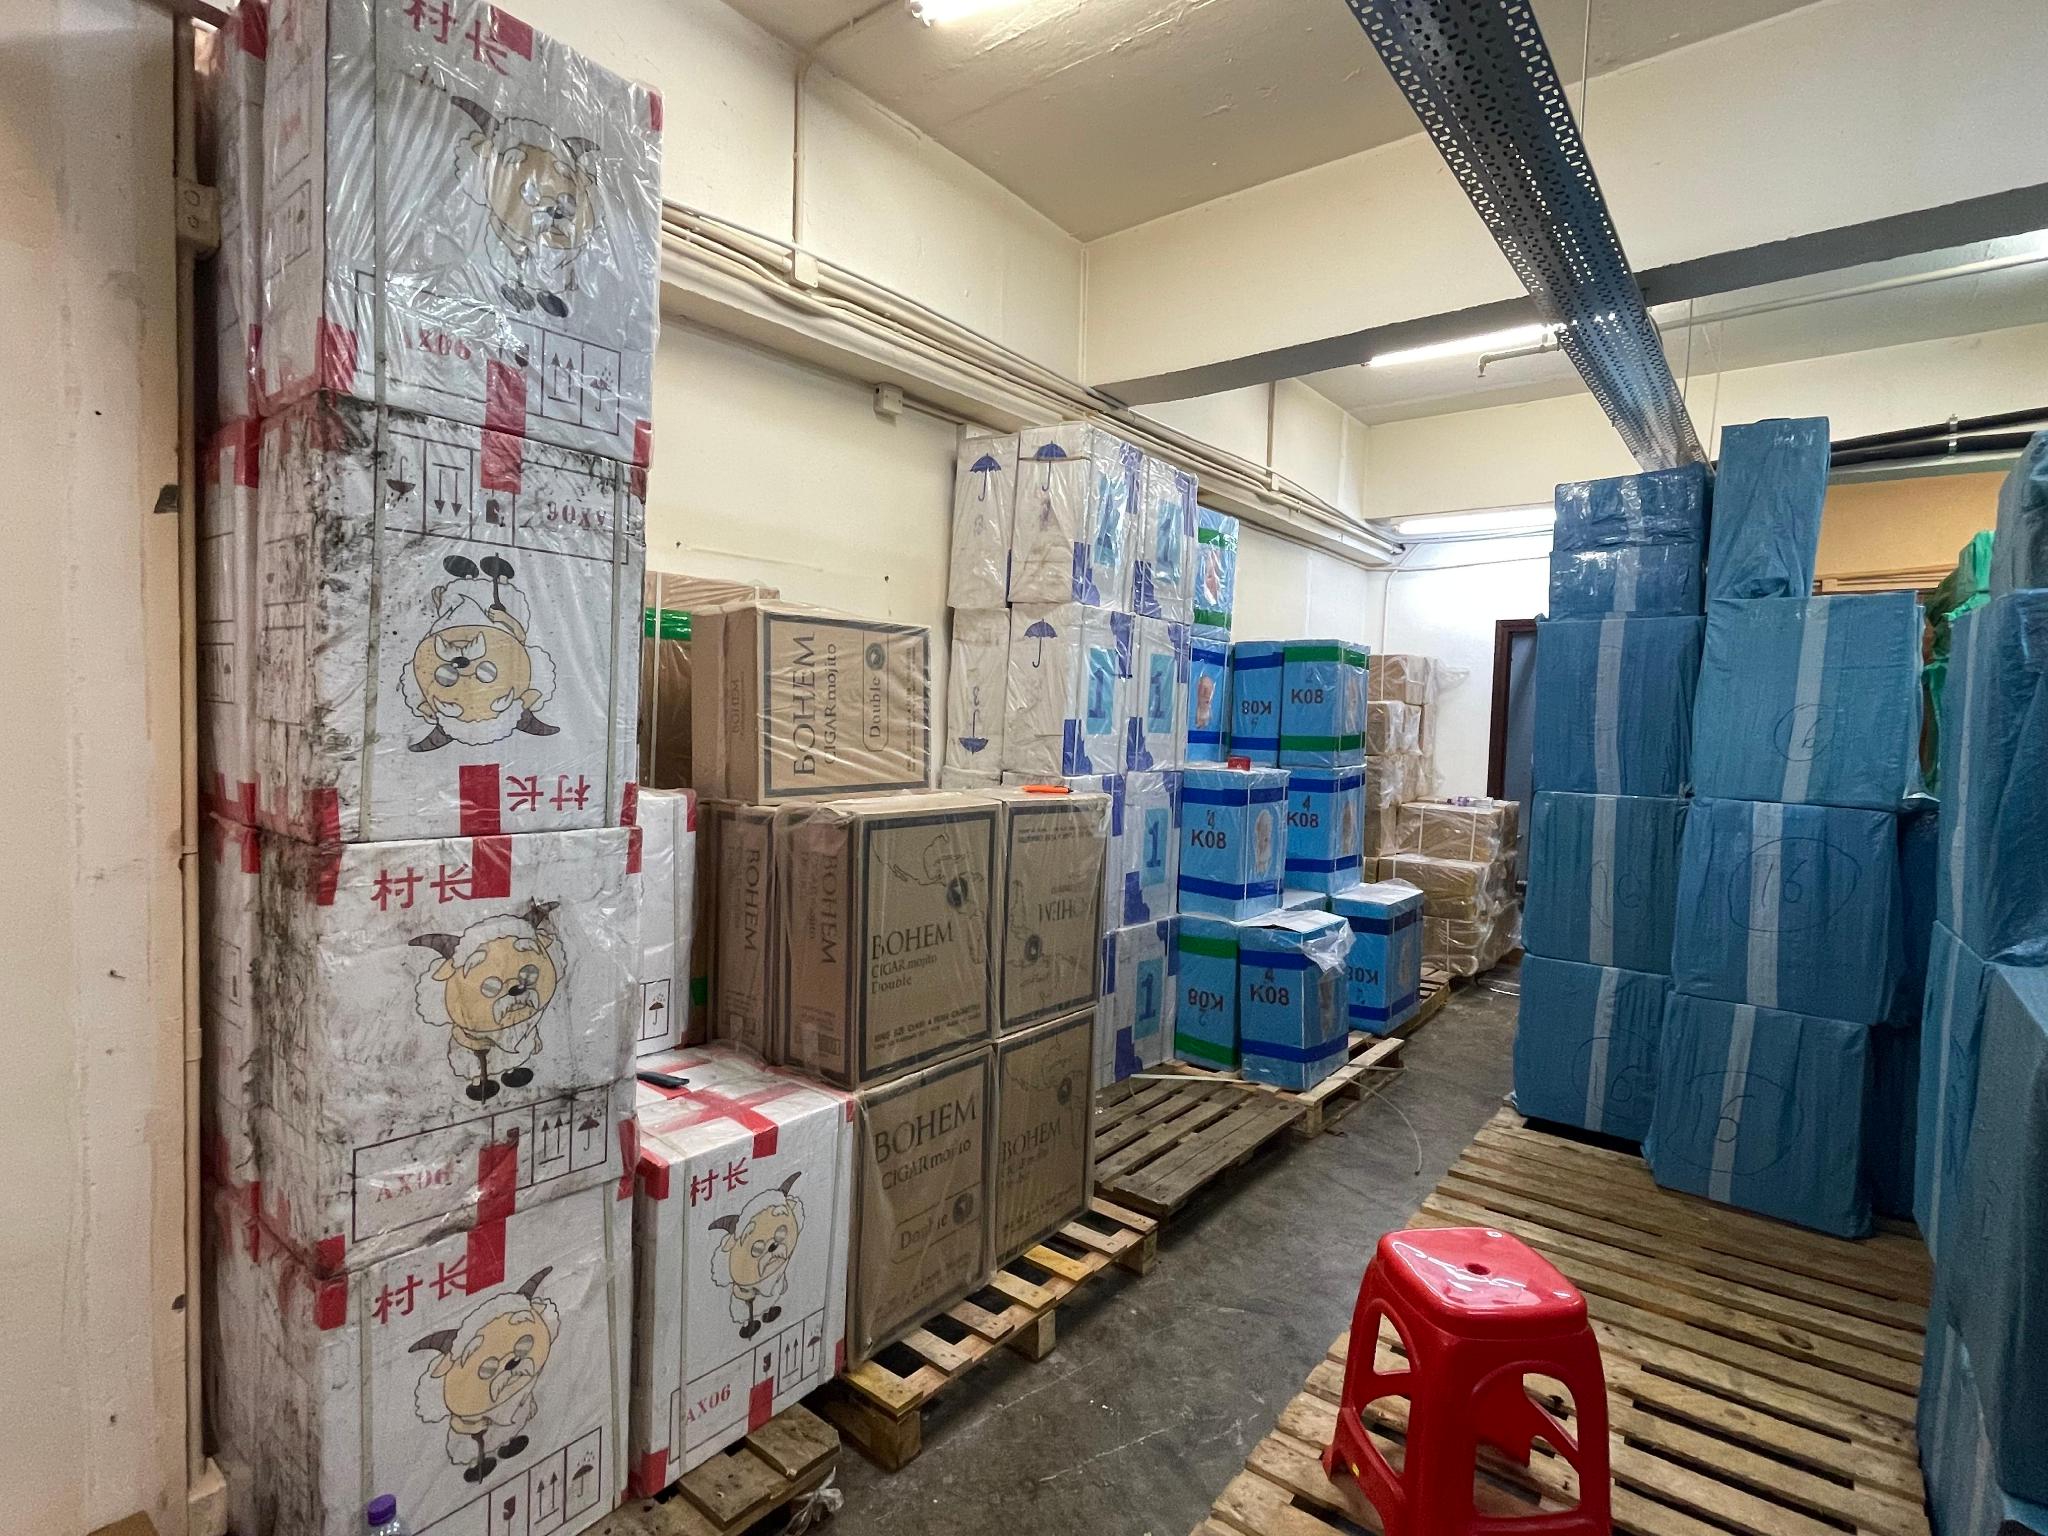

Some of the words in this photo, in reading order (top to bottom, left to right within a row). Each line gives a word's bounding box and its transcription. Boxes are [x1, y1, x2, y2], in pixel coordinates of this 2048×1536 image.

[402, 0, 508, 76] 村长
[793, 632, 815, 776] BOHEM
[870, 677, 881, 738] Double
[1242, 701, 1272, 715] K08
[1291, 689, 1324, 704] K08
[506, 773, 592, 812] 村长
[1303, 795, 1310, 811] 4
[1191, 829, 1227, 849] K08
[1207, 810, 1215, 829] 4
[1287, 811, 1319, 828] K08
[1146, 820, 1161, 868] 1
[371, 863, 474, 911] 村长
[745, 850, 760, 951] BOHEM
[1762, 859, 1808, 907] 16
[820, 855, 838, 964] BOHEM
[872, 921, 954, 960] BOHEM
[872, 975, 912, 994] Double
[1139, 973, 1156, 1021] 1
[1188, 988, 1223, 1012] K08
[1250, 984, 1290, 1006] K08
[874, 1092, 977, 1164] BOHEM
[1002, 1119, 1061, 1163] BOHEM
[690, 1157, 749, 1207] 村长
[371, 1258, 471, 1324] 村长
[686, 1384, 731, 1423] AX06
